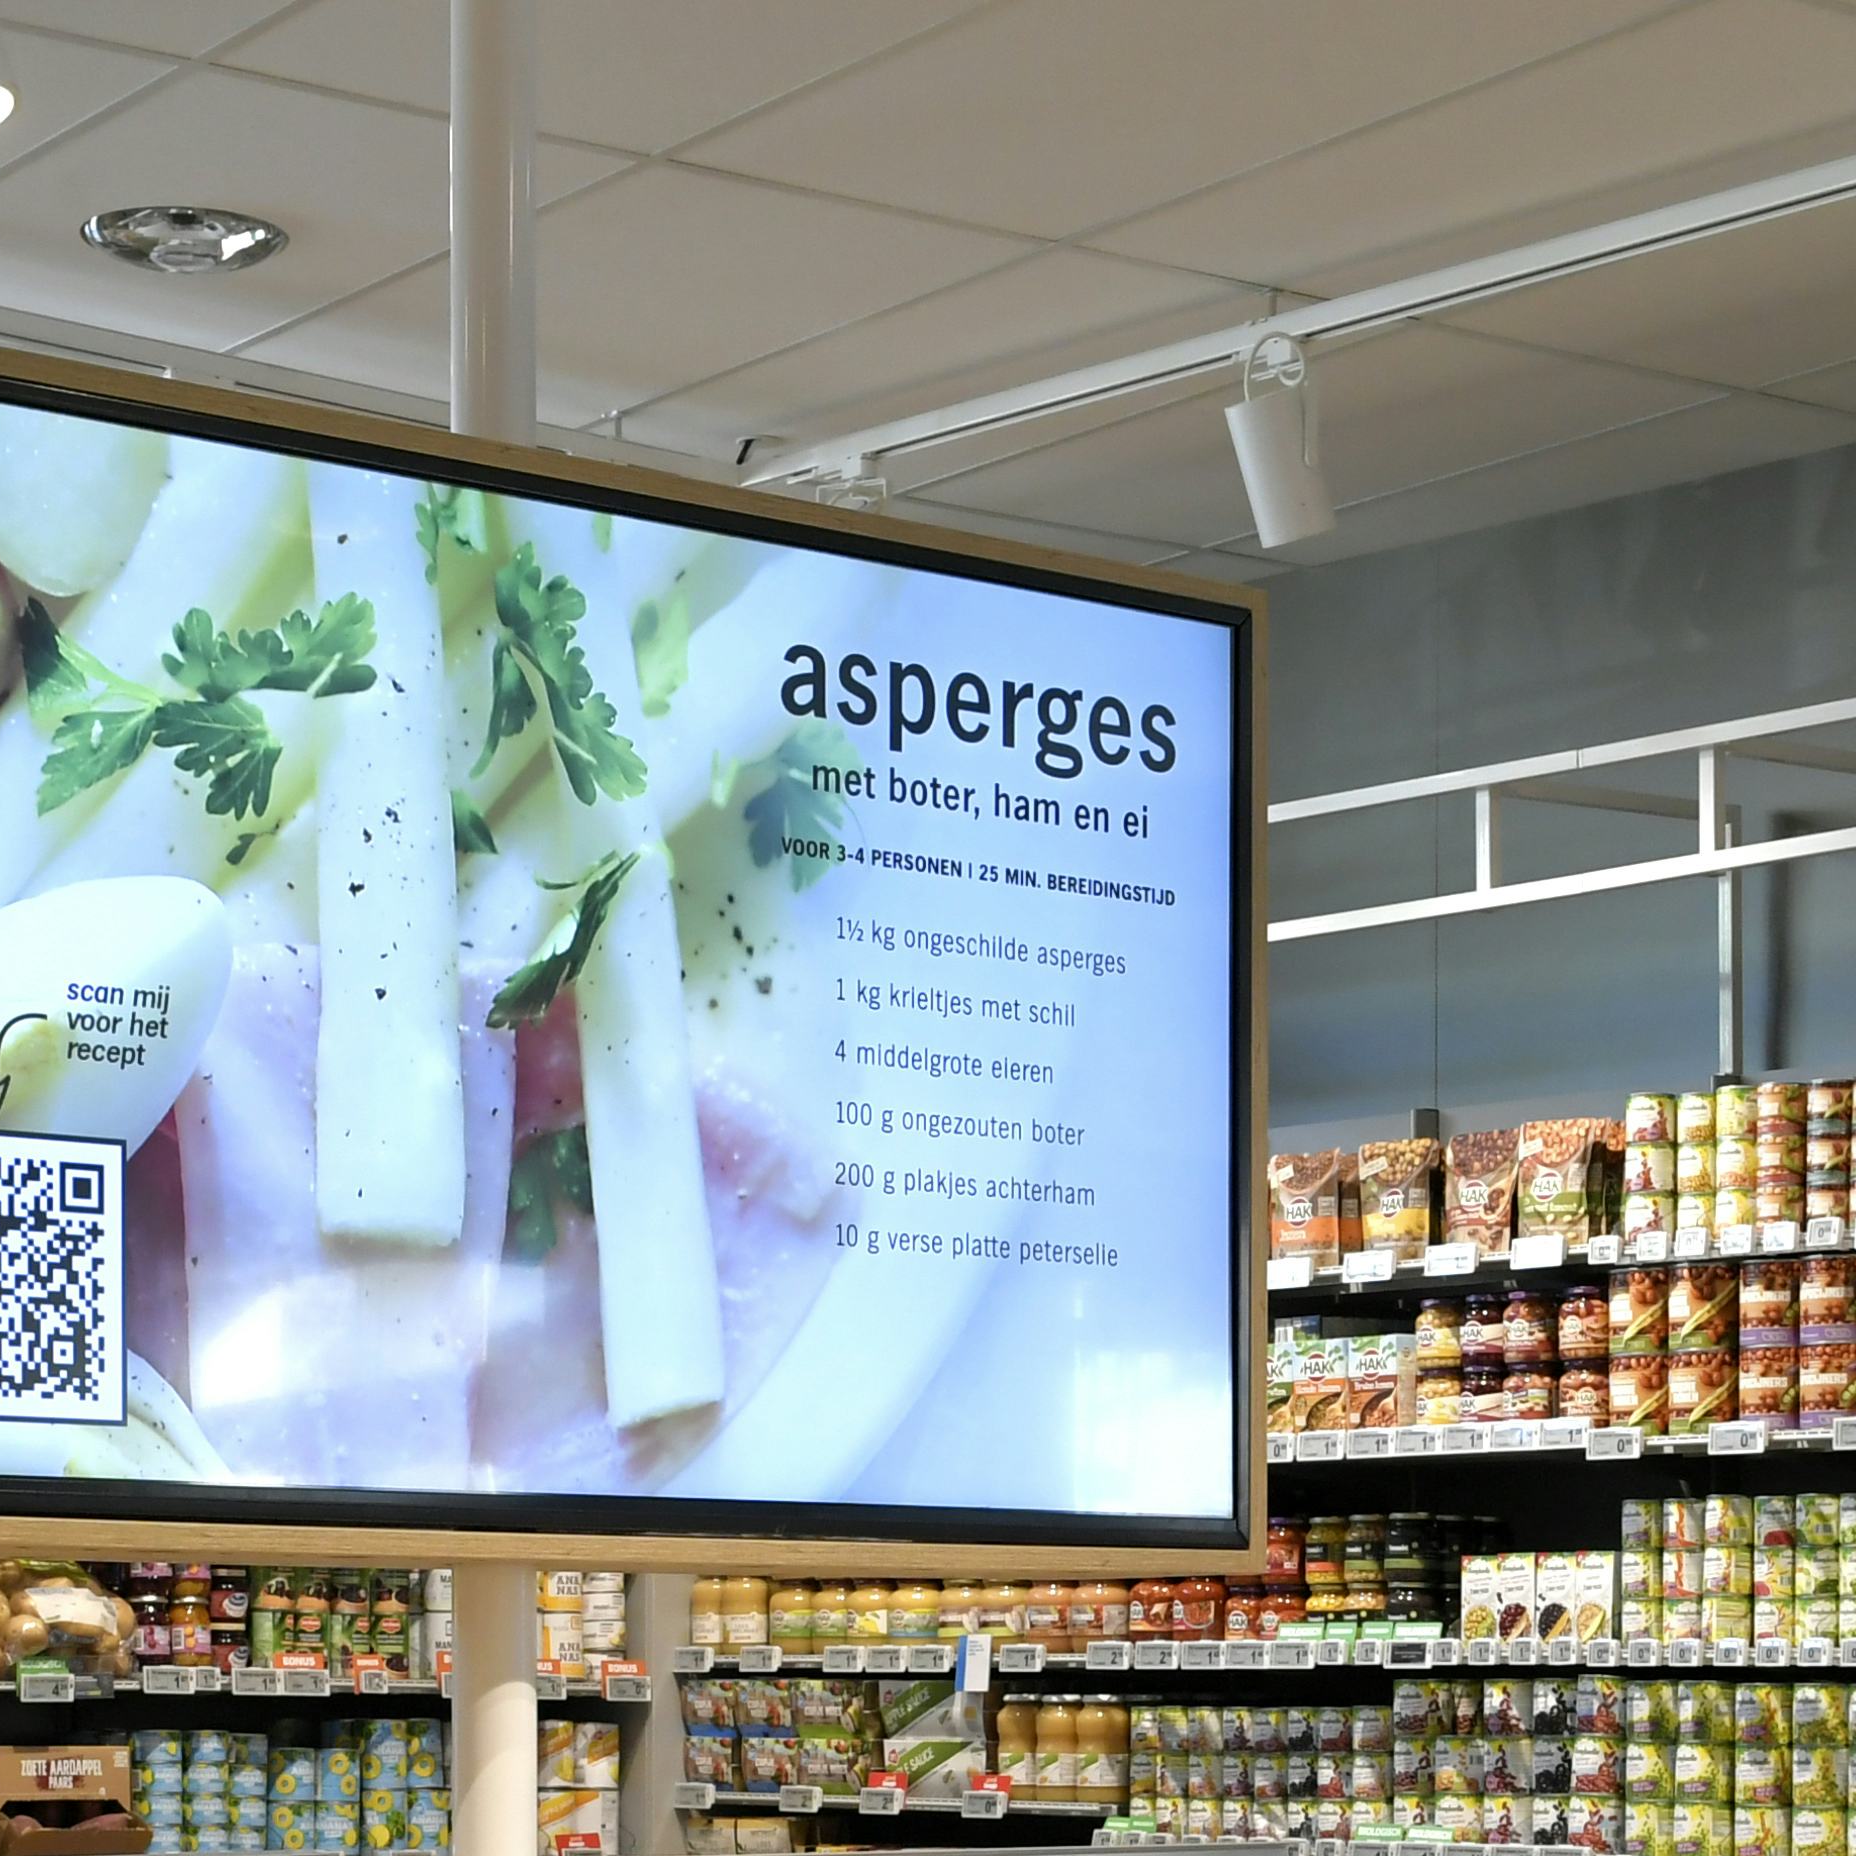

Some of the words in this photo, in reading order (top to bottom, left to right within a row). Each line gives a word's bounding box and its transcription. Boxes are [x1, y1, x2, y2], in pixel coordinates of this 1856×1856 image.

[780, 644, 1177, 779] asperges
[812, 764, 875, 798] met
[889, 768, 980, 820] boter,
[994, 784, 1060, 826] ham
[1074, 805, 1109, 833] en
[1124, 805, 1149, 838] ei
[782, 837, 830, 859] VOOR
[837, 845, 865, 865] 3-4
[872, 849, 961, 878] PERSONEN
[979, 863, 998, 882] 25
[1005, 868, 1041, 889] MIN.
[1048, 873, 1175, 906] BEREIDINGSTIJD
[872, 920, 895, 950] kg
[904, 928, 1028, 961] ongeschilde
[1037, 943, 1126, 976] asperges
[67, 982, 124, 1005] scan
[133, 986, 170, 1014] mij
[837, 978, 845, 1001] 1
[857, 980, 881, 1010] kg
[890, 983, 972, 1018] krieltjes
[982, 1000, 1021, 1021] met
[1029, 1003, 1075, 1026] schil
[67, 1011, 122, 1035] voor
[130, 1013, 169, 1038] het
[67, 1039, 146, 1070] recept
[835, 1039, 846, 1061] 4
[857, 1043, 982, 1078] middelgrote
[992, 1057, 1054, 1083] eieren
[837, 1101, 872, 1126] 100
[881, 1108, 893, 1133] g
[902, 1109, 1022, 1141] ongezouten
[1032, 1118, 1085, 1146] boter
[835, 1162, 874, 1187] 200
[883, 1169, 895, 1195] g
[904, 1168, 977, 1199] plakjes
[986, 1177, 1095, 1205] achterham
[1460, 1188, 1488, 1203] HAK
[1286, 1203, 1312, 1221] HAK
[837, 1224, 858, 1246] 10
[868, 1230, 880, 1254] g
[888, 1231, 943, 1254] verse
[953, 1232, 1010, 1259] platte
[1020, 1239, 1118, 1267] peterselie
[1303, 1358, 1331, 1375] HAK
[1359, 1354, 1385, 1372] HAK
[556, 1575, 579, 1586] ANA
[556, 1586, 581, 1596] NAS
[559, 1641, 581, 1653] ANA
[559, 1652, 582, 1662] NAS
[282, 1655, 316, 1667] BONUS
[608, 1664, 638, 1674] BONUS
[20, 1760, 47, 1777] ZOETE
[49, 1759, 102, 1777] AARDAPPEL
[48, 1776, 74, 1789] PAARS
